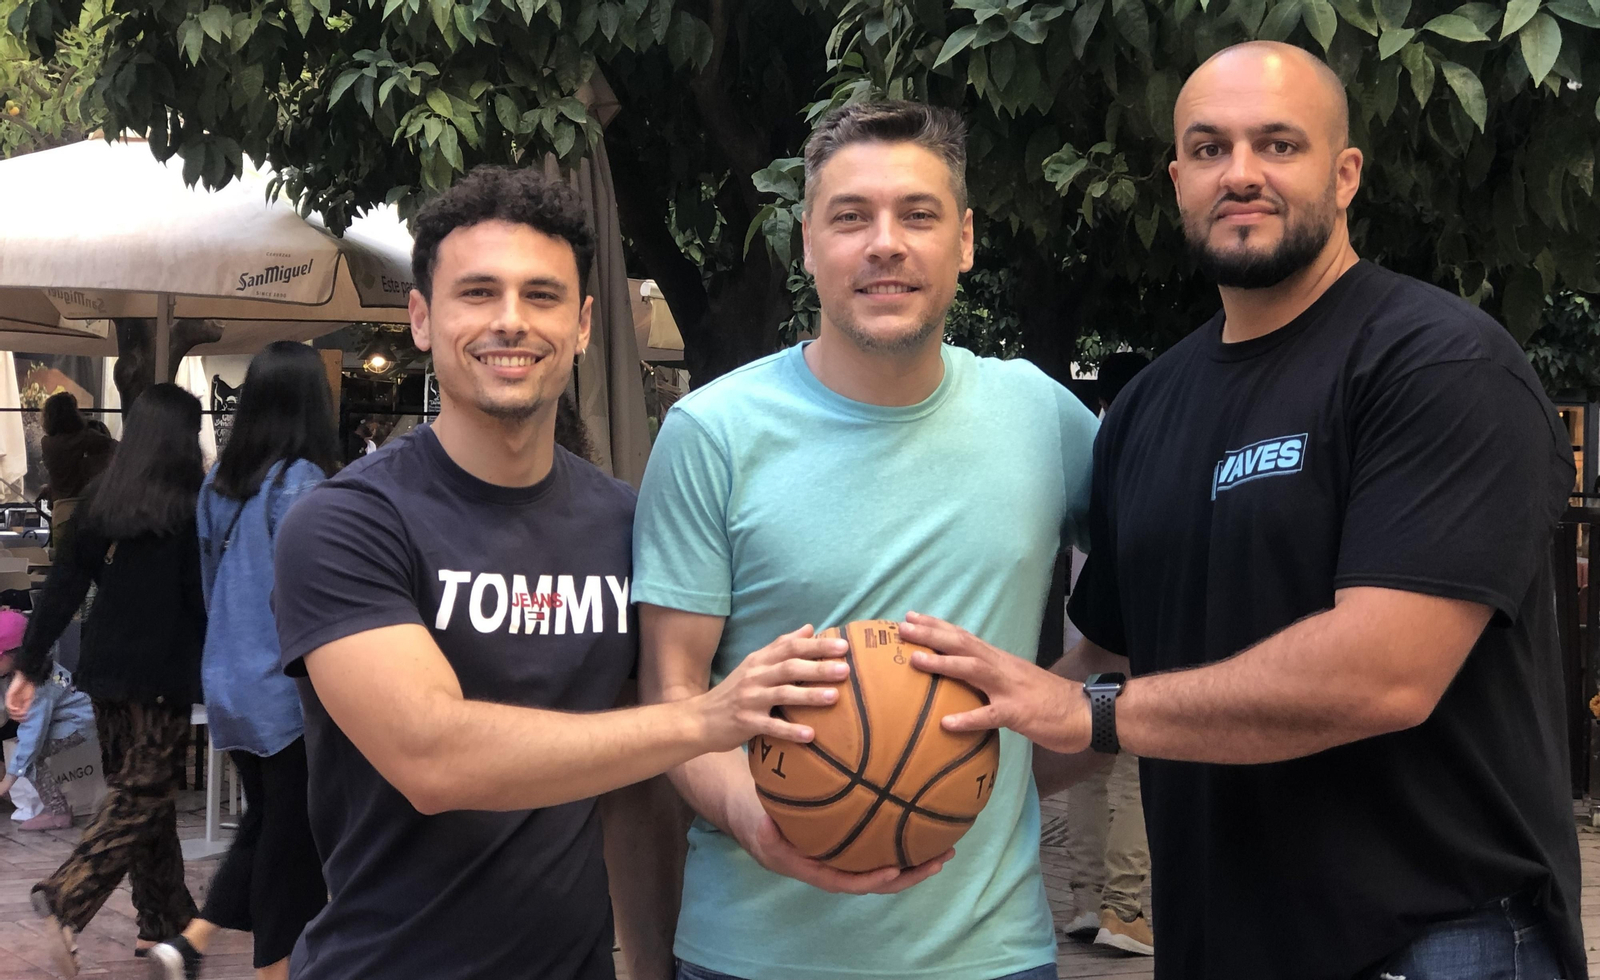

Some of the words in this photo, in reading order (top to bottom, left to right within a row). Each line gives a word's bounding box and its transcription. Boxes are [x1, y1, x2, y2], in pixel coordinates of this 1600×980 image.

[381, 275, 400, 293] Este
[435, 569, 629, 635] TOMMY
[512, 592, 563, 608] JEANS
